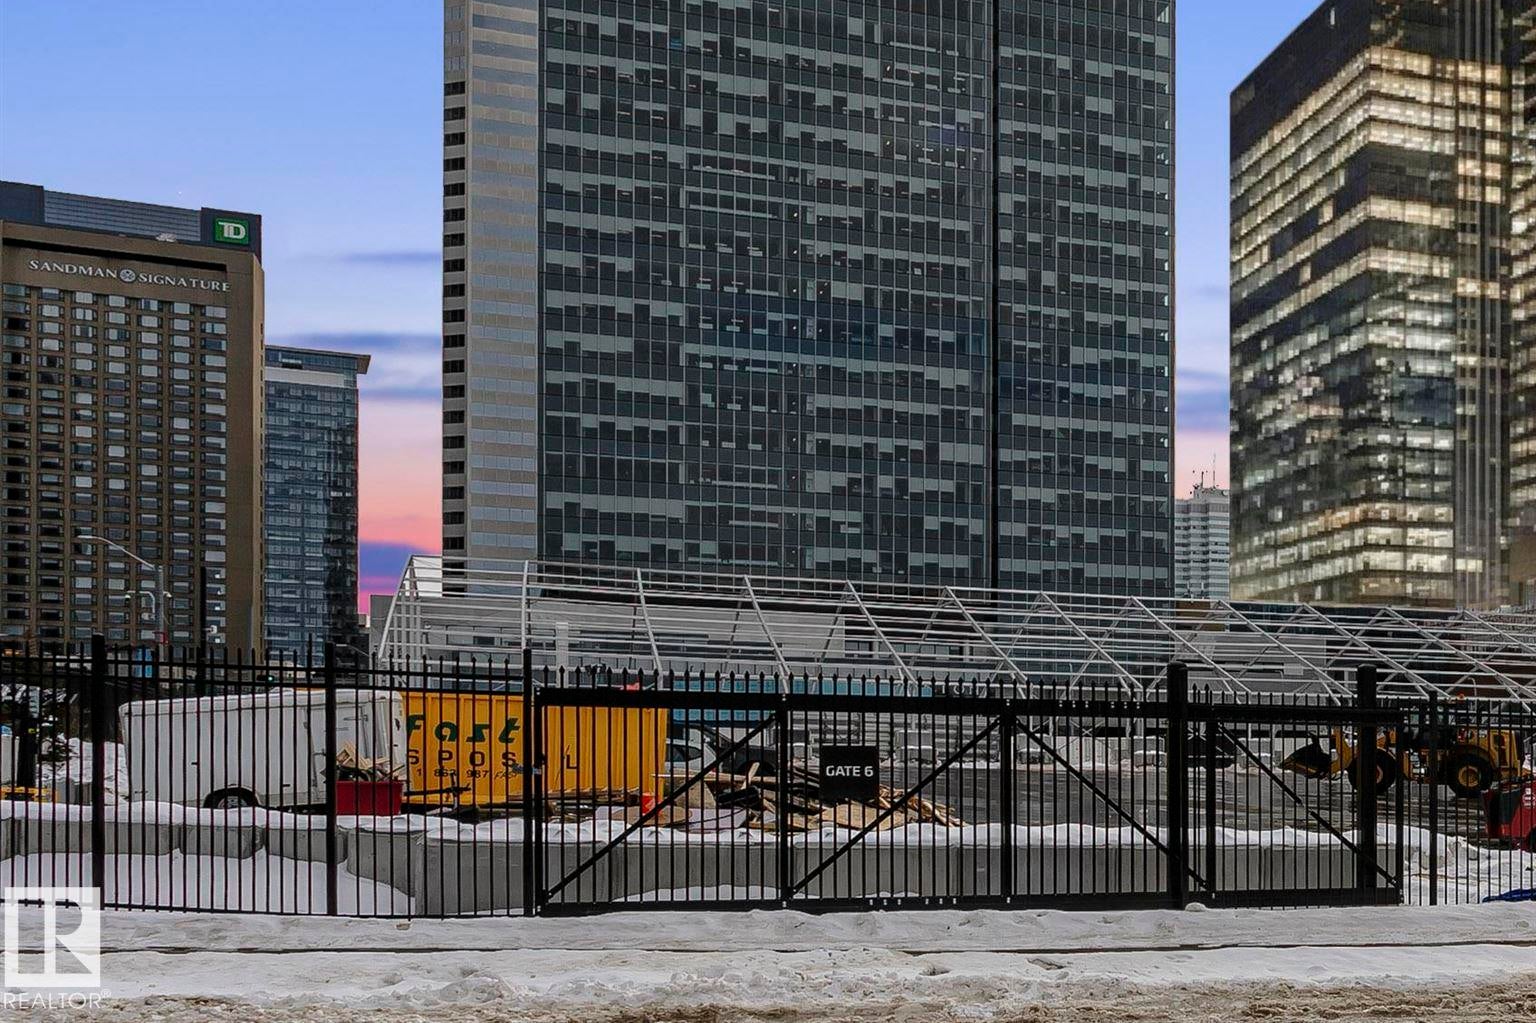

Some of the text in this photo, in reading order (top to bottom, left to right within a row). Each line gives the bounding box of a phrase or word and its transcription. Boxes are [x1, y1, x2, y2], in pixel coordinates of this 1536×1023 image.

[218, 221, 246, 240] TD
[28, 259, 231, 292] SANDMAN SIGNATURE
[826, 765, 874, 777] GATE 6
